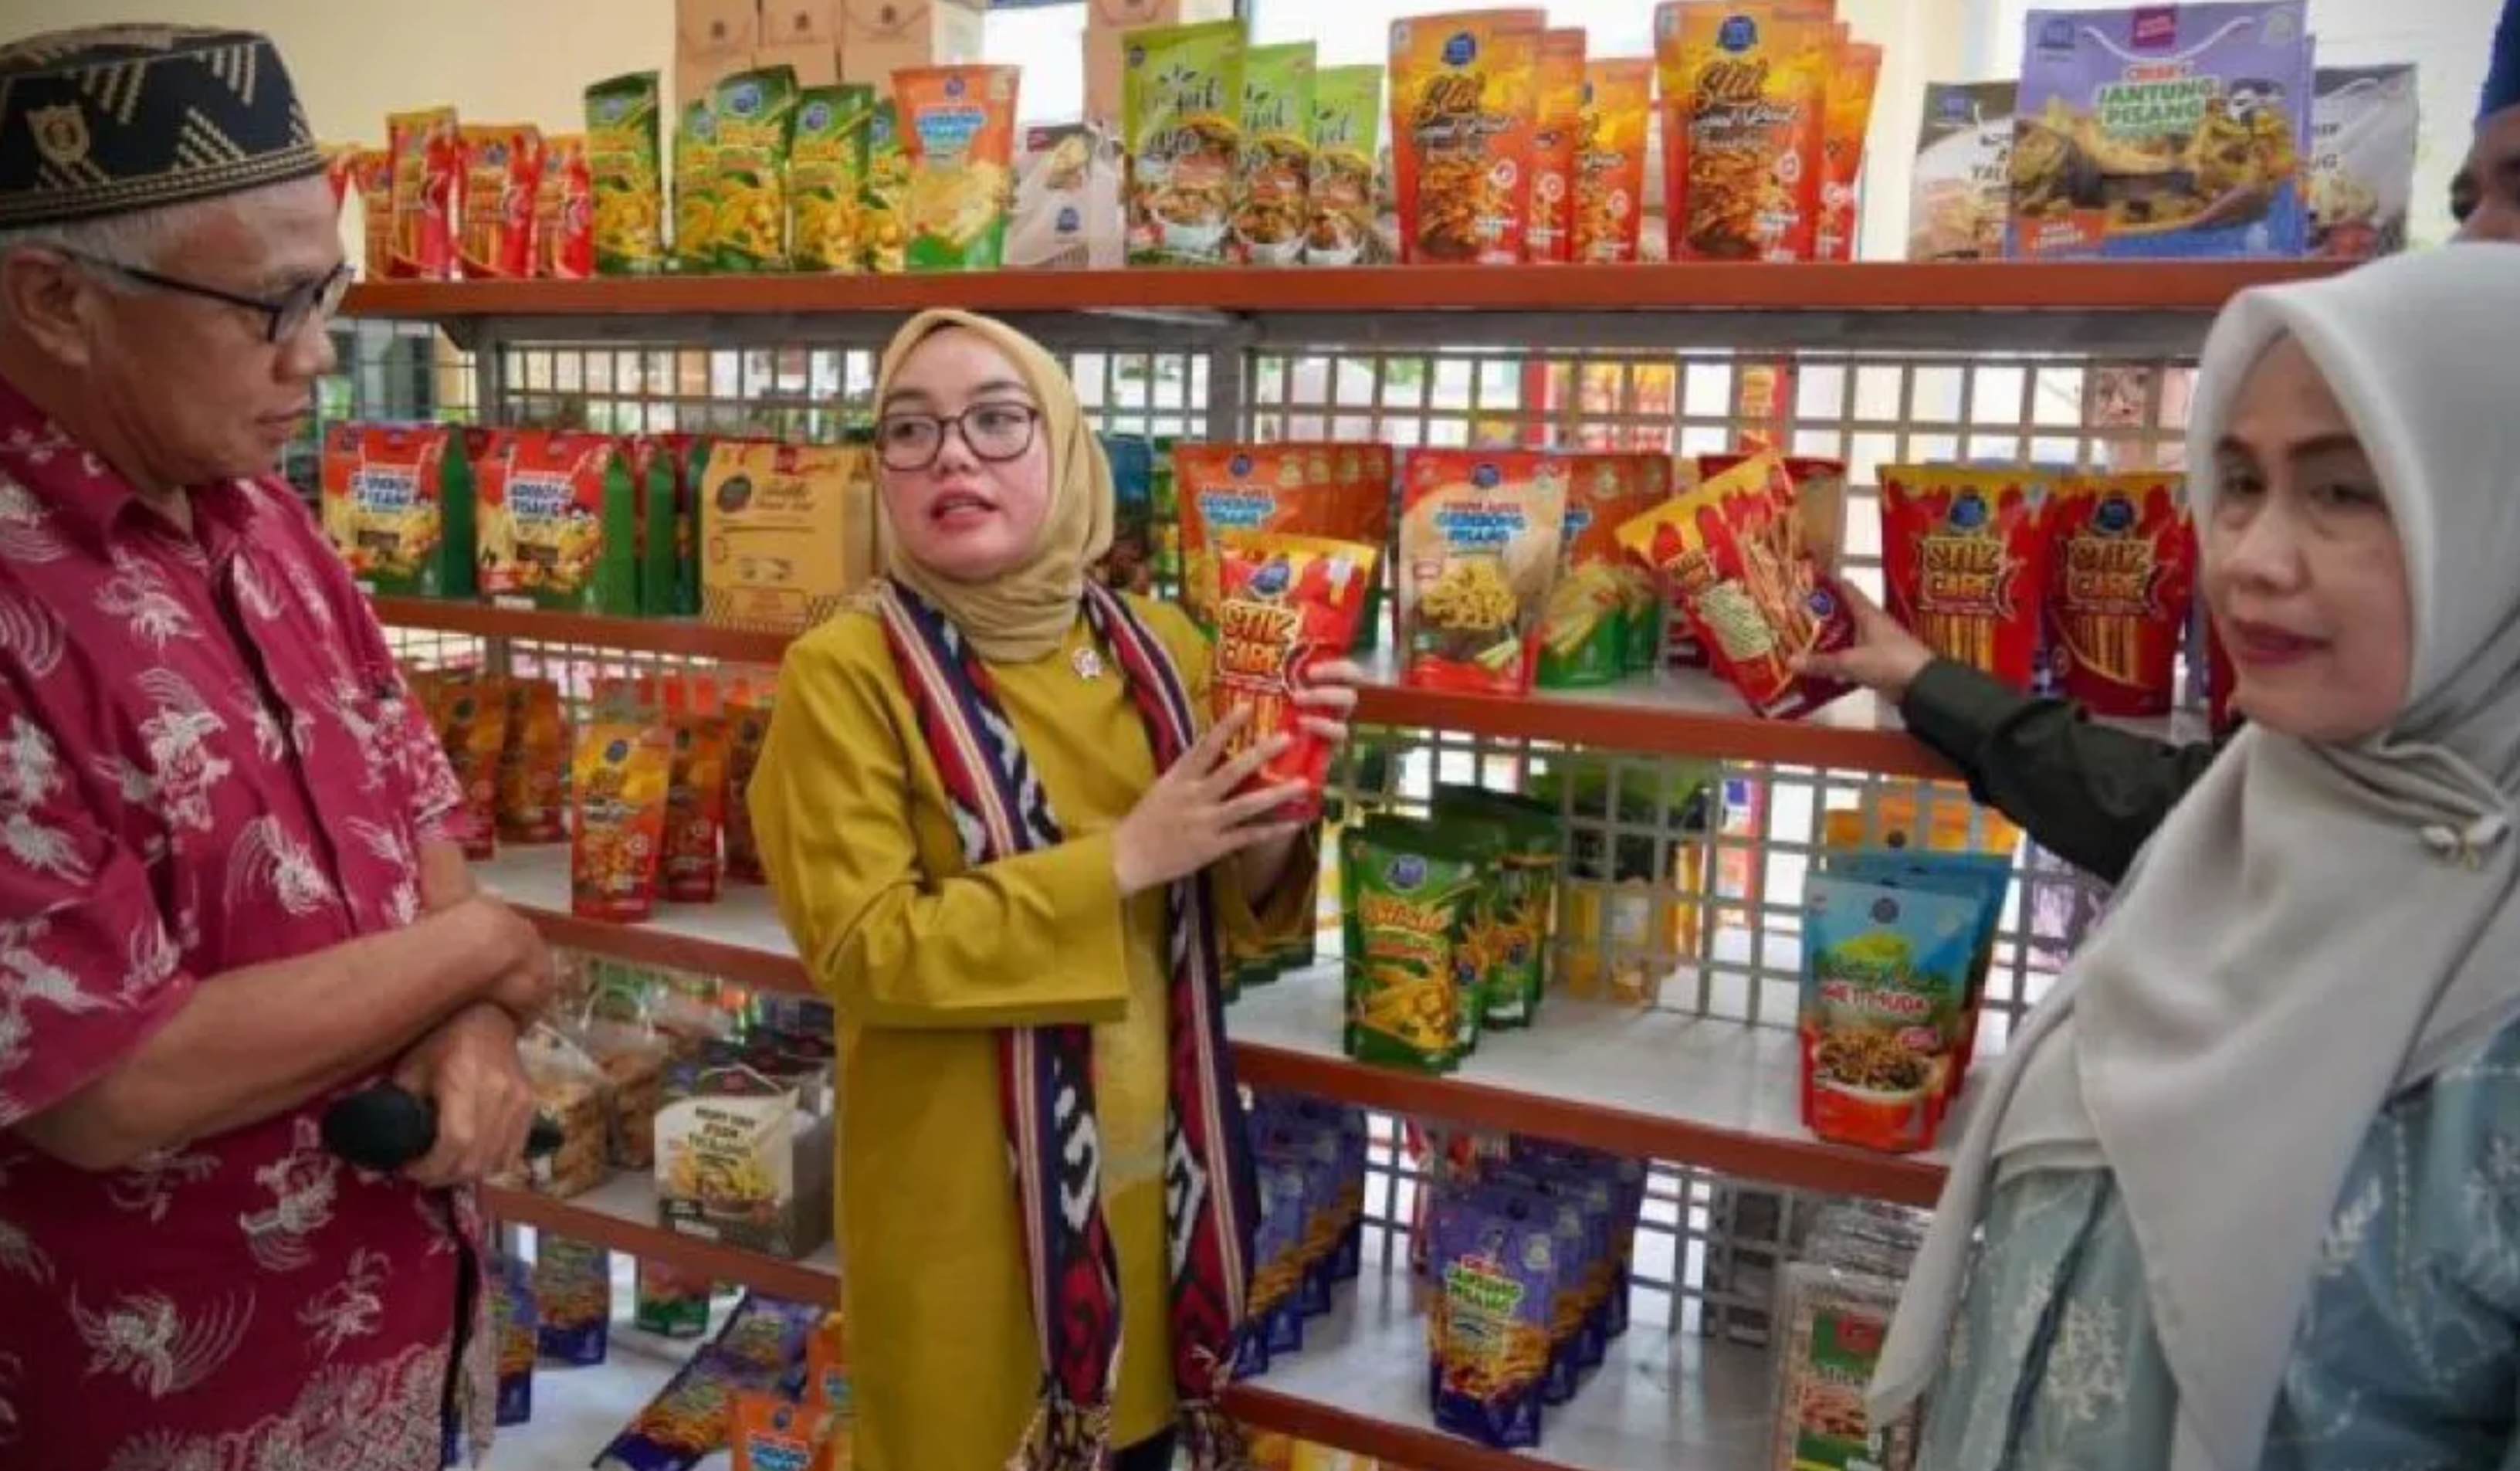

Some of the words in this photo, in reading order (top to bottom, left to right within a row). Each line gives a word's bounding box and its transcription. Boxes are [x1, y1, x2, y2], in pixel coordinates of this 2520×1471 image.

[2097, 77, 2219, 103] JANTUNG
[2105, 100, 2205, 127] PISANG
[1926, 541, 2001, 571] STIK
[2074, 541, 2152, 571] STIK
[1224, 605, 1296, 642] STIK
